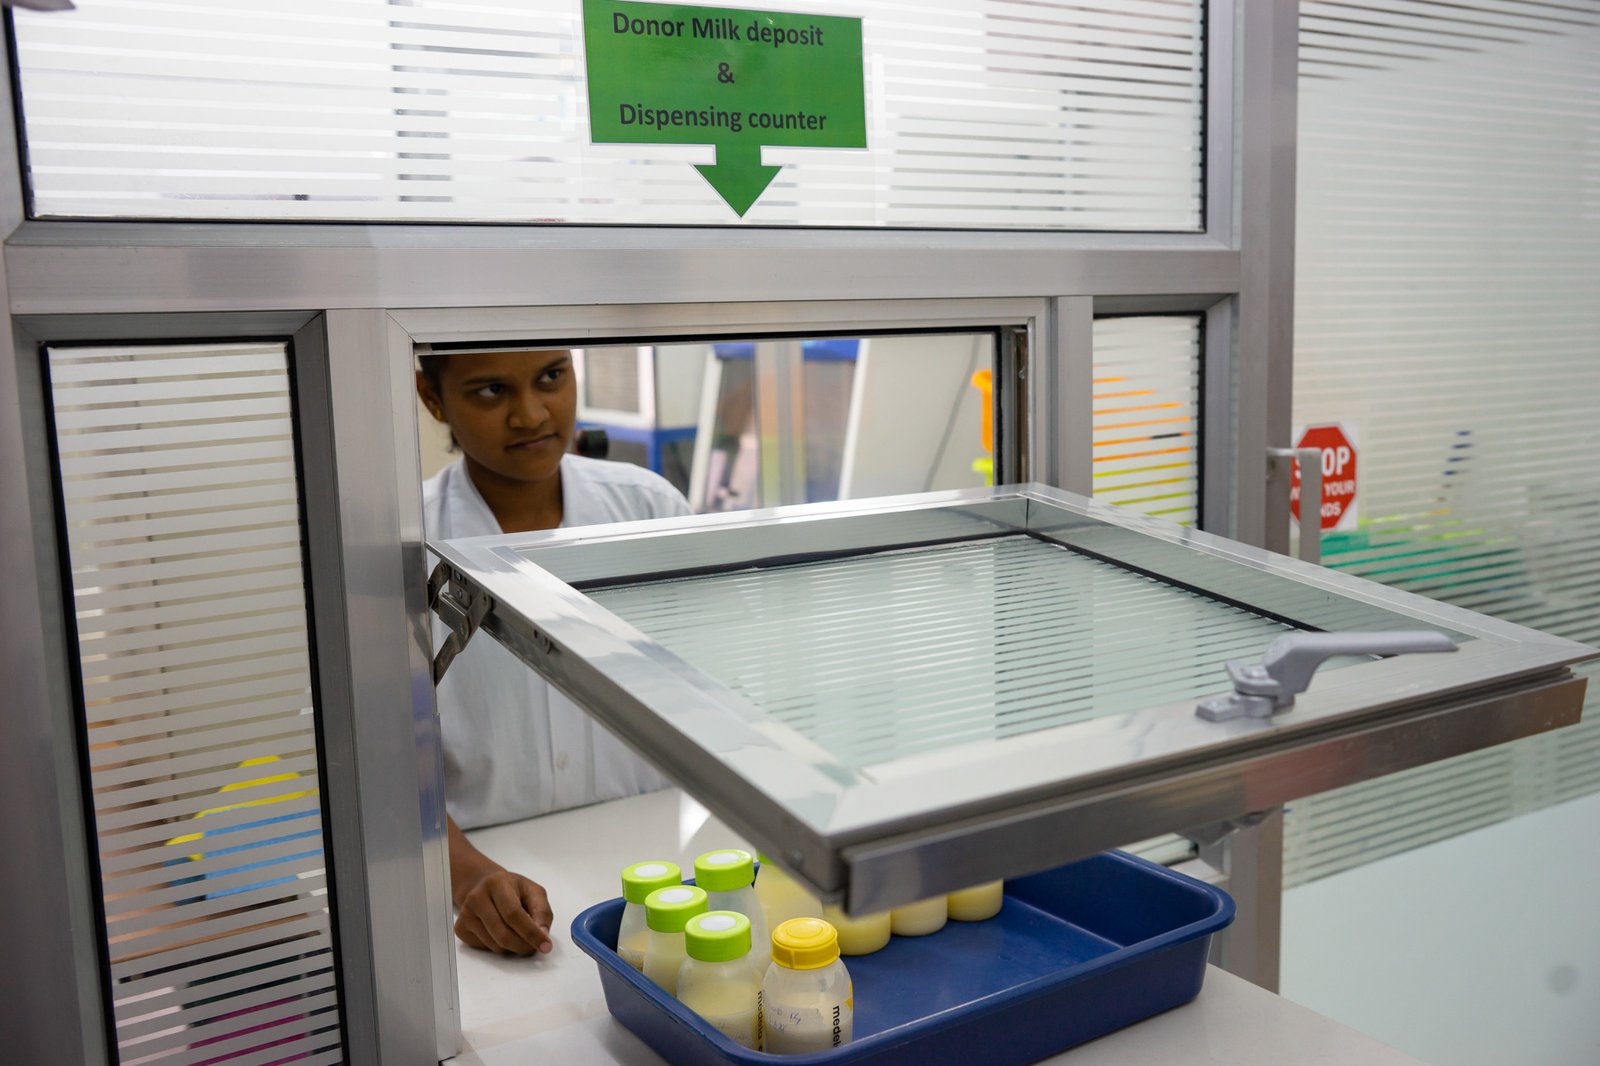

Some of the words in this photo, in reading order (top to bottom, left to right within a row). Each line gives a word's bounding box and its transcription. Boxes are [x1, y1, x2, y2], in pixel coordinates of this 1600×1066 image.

[613, 12, 685, 37] Donor
[692, 17, 741, 41] Milk
[747, 20, 824, 48] deposit
[717, 62, 735, 84] &
[619, 103, 742, 132] Dispensing
[748, 112, 827, 130] counter
[1323, 480, 1355, 497] YOUR
